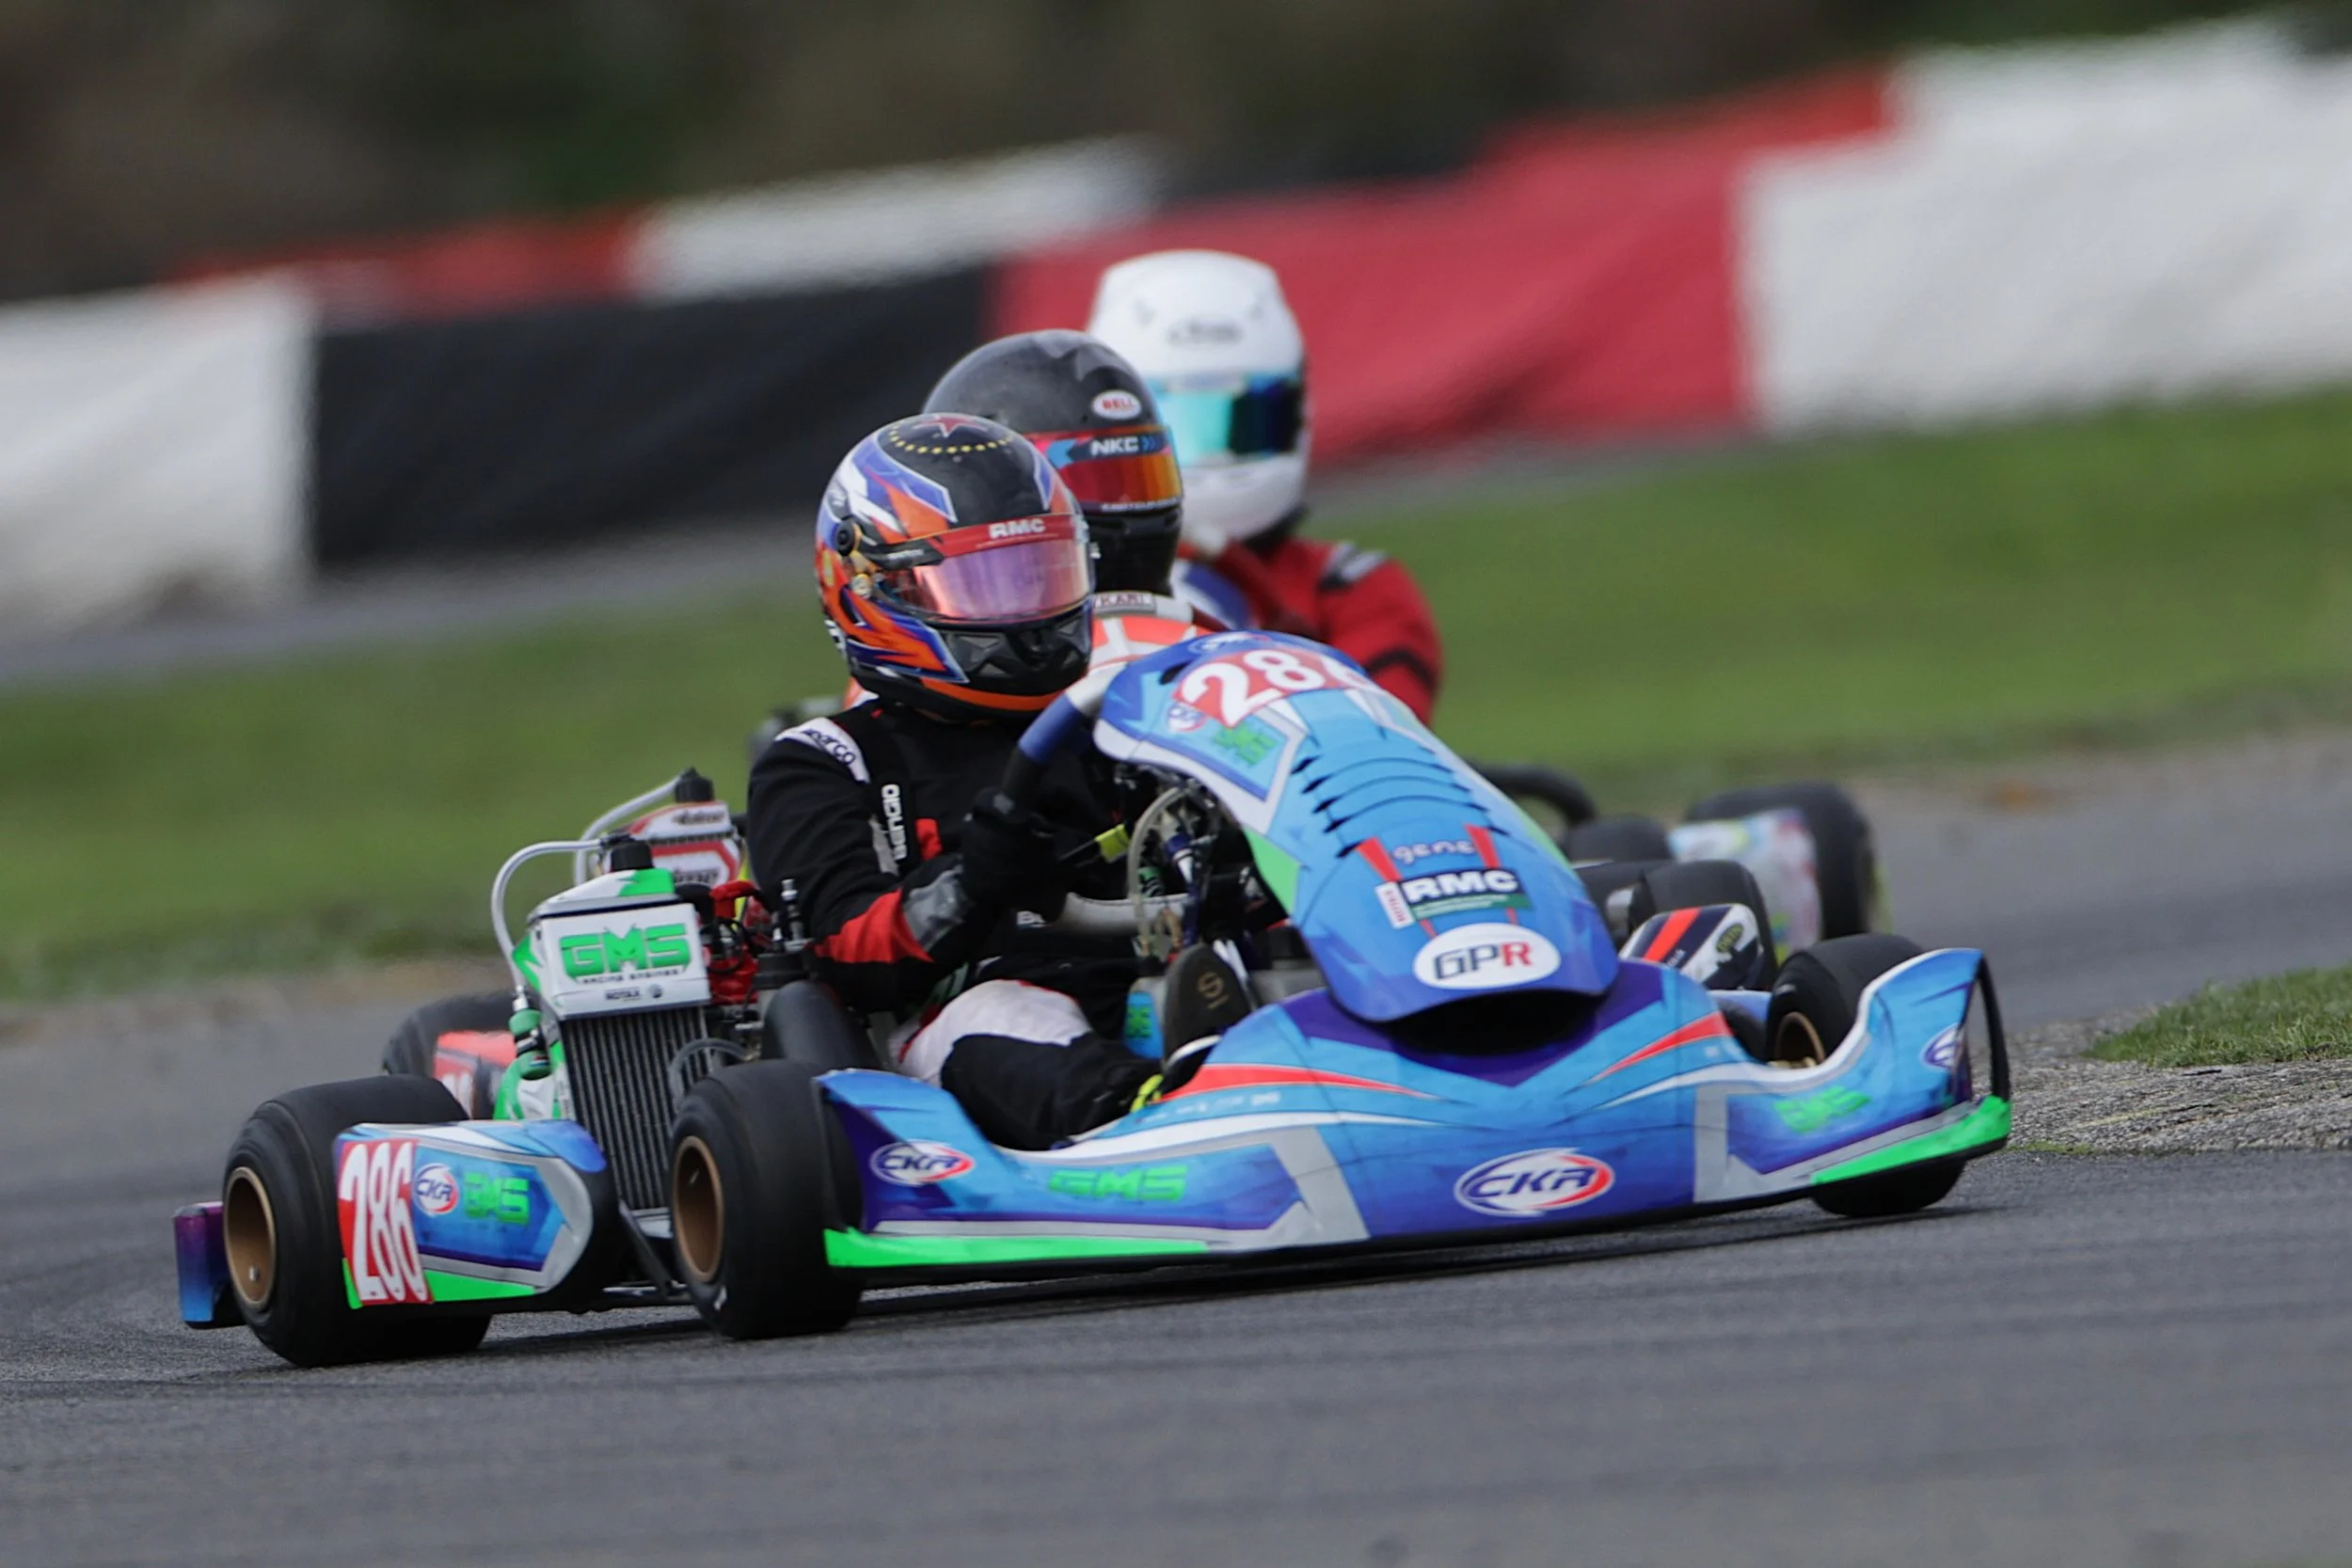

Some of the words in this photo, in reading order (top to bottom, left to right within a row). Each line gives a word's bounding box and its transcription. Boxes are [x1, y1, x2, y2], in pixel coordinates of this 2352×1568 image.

[1101, 399, 1135, 411] BELL
[1090, 436, 1139, 457] NKC
[989, 518, 1046, 539] RMC
[1401, 870, 1519, 904] RMC
[559, 923, 691, 980] GMS
[1434, 941, 1533, 981] GPR
[1048, 1164, 1188, 1201] GMS
[339, 1141, 427, 1302] 286
